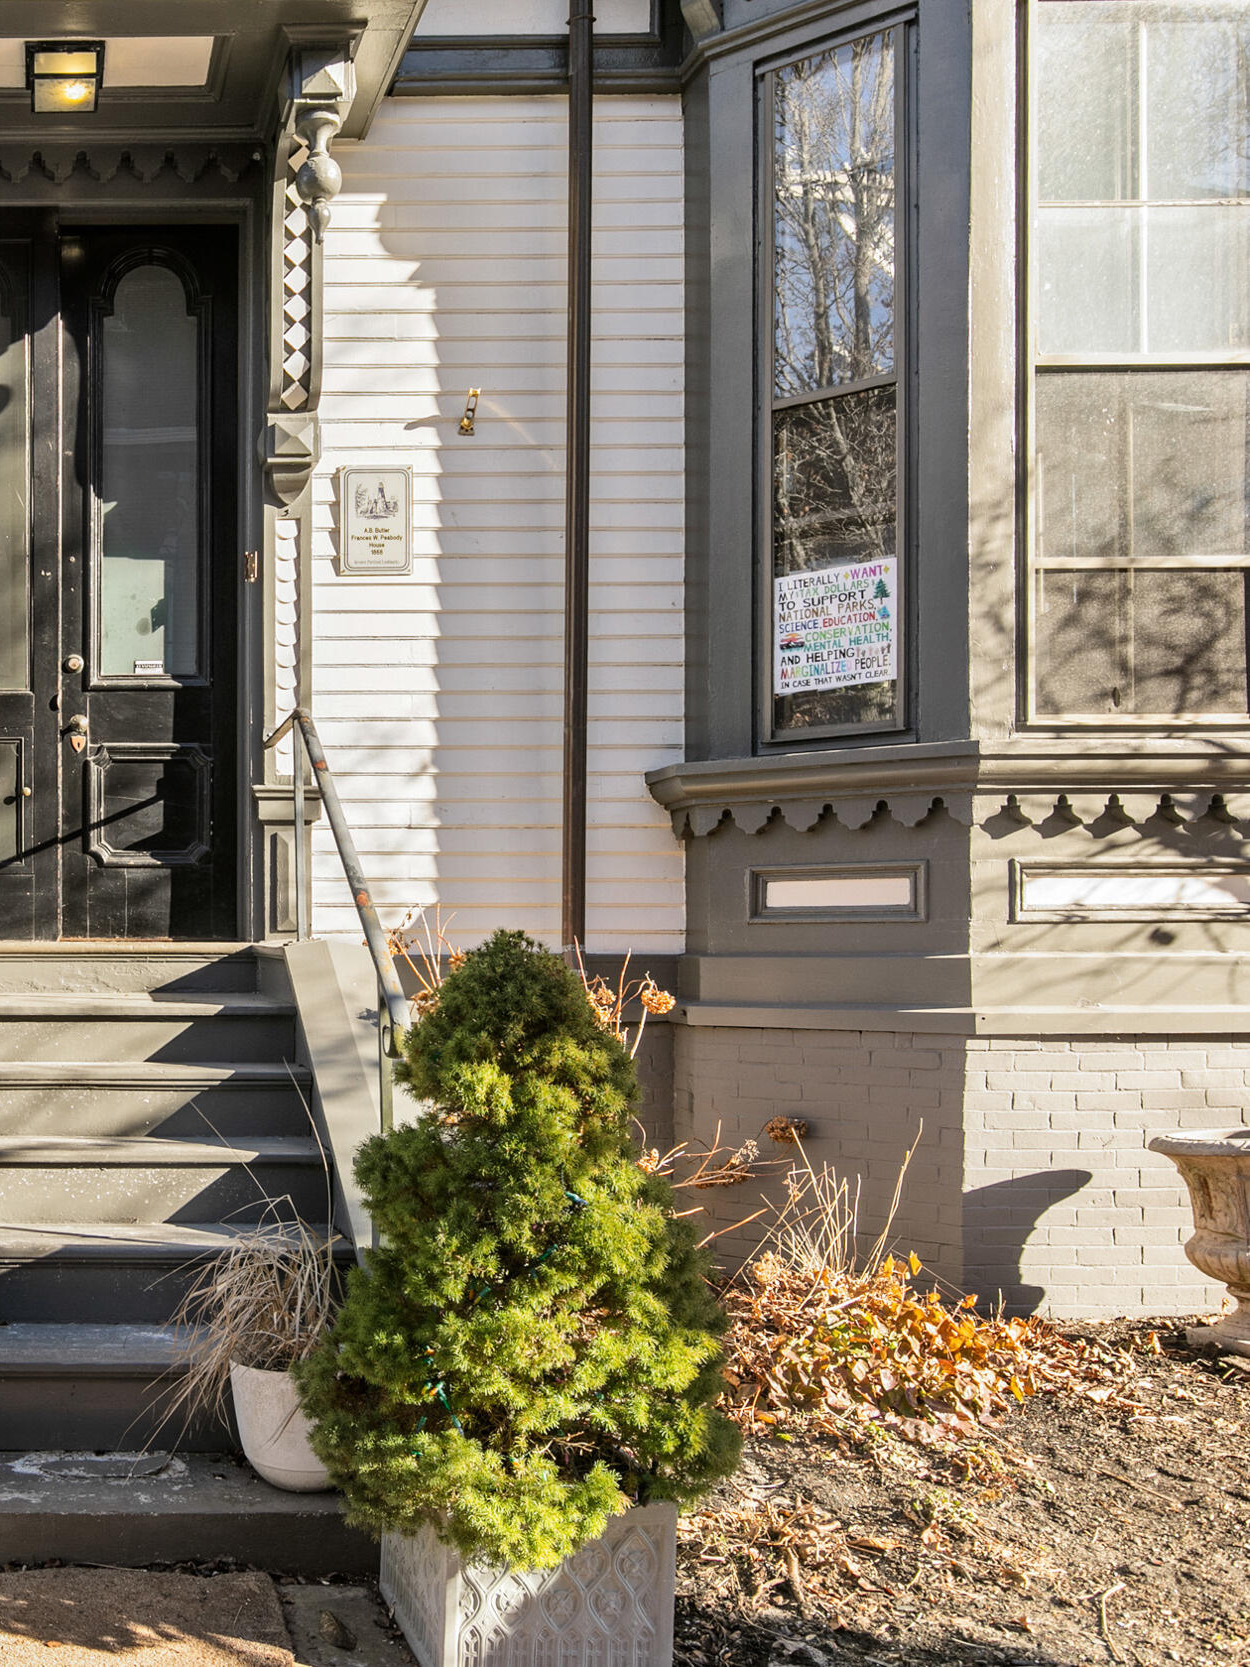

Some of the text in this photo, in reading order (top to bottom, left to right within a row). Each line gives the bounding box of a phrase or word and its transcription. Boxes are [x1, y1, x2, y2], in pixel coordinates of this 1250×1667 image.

[381, 534, 403, 542] Peabody
[778, 565, 884, 592] I LITERALLY WANT
[778, 591, 794, 602] MY
[824, 579, 870, 594] DOLLARS
[780, 589, 866, 612] TO SUPPORT
[779, 606, 832, 623] NATIONAL
[804, 639, 843, 653] MENTAL
[781, 648, 855, 666] AND HELPING
[781, 660, 851, 680] MARGINALIZED
[781, 681, 789, 689] IN
[793, 680, 810, 688] CASE
[815, 677, 832, 685] THAT
[836, 673, 862, 682] WASN'T
